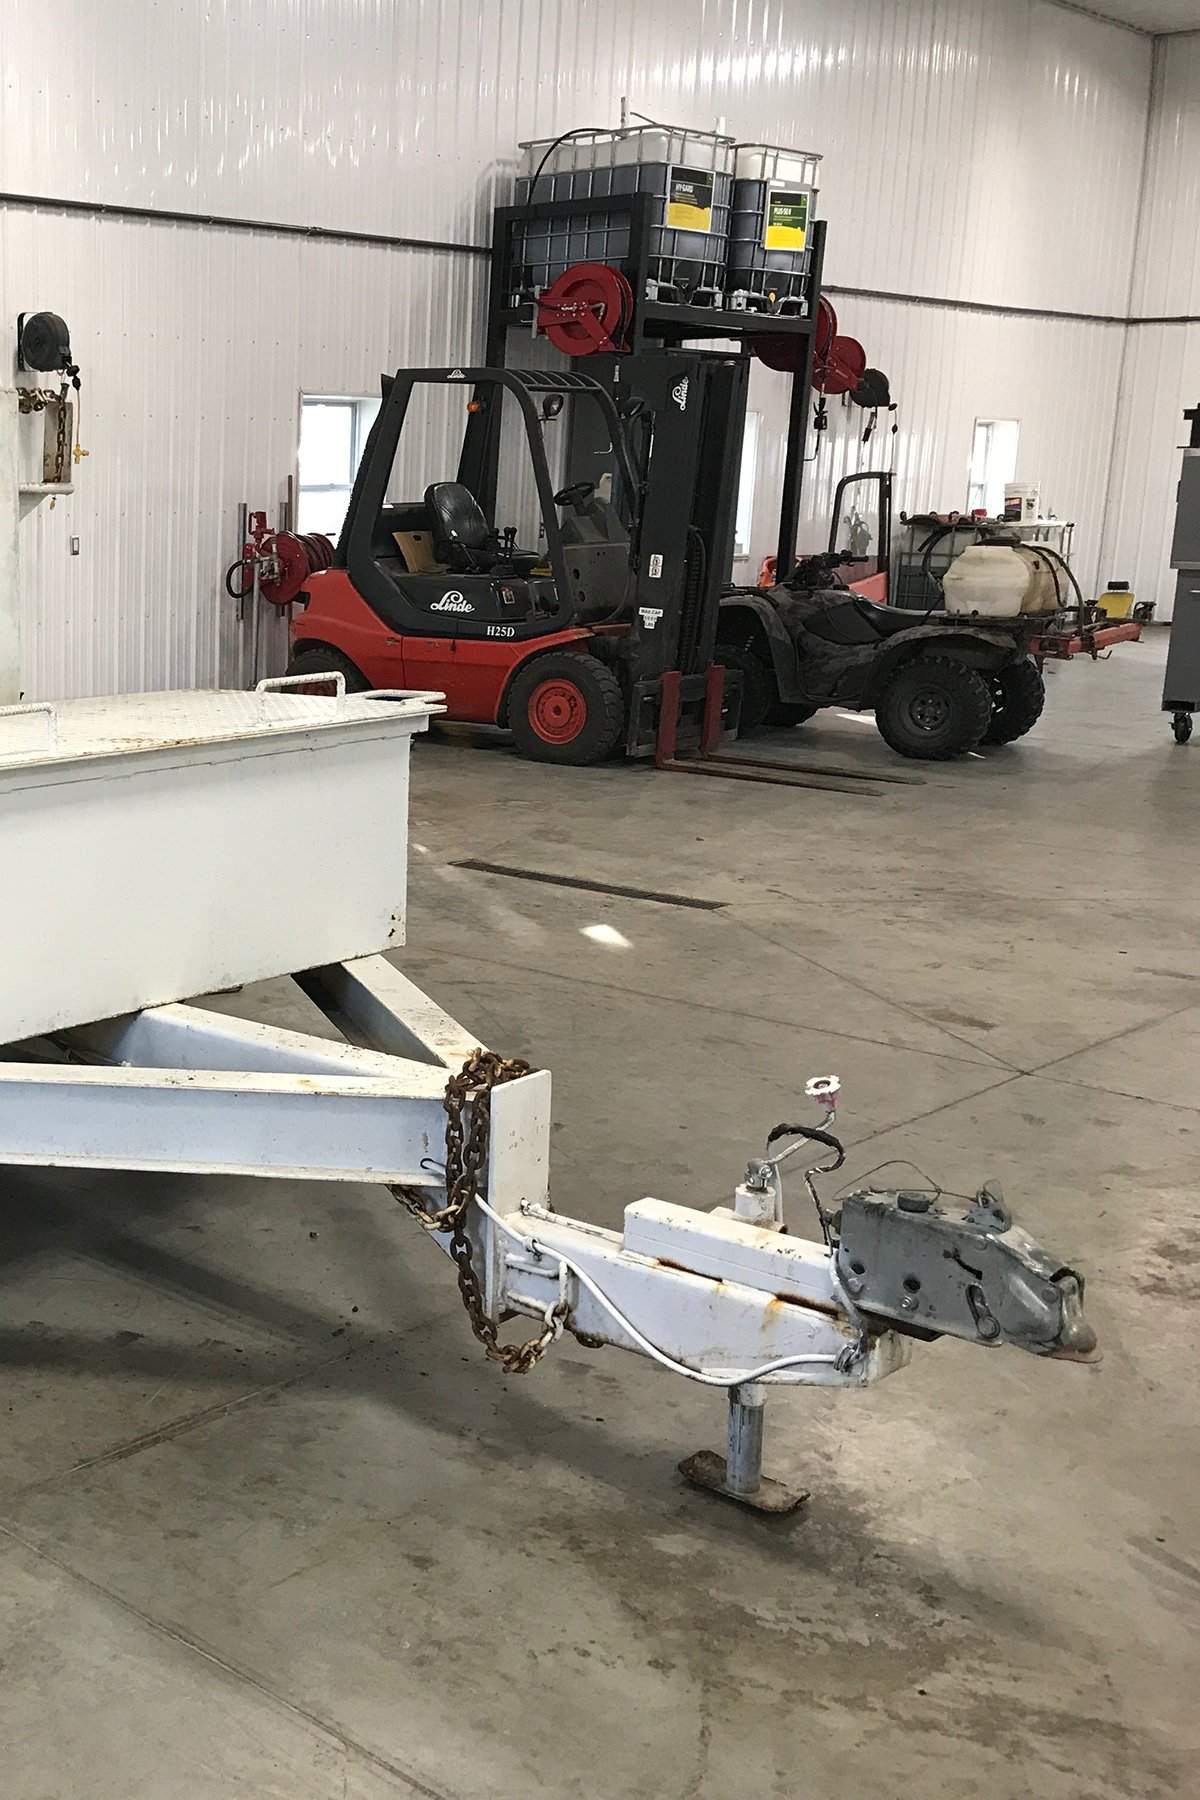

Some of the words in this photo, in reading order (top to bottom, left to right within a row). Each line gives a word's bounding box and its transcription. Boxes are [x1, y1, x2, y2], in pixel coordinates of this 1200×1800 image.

[672, 376, 689, 410] Linde
[430, 590, 475, 613] Linde
[486, 625, 515, 638] H25D
